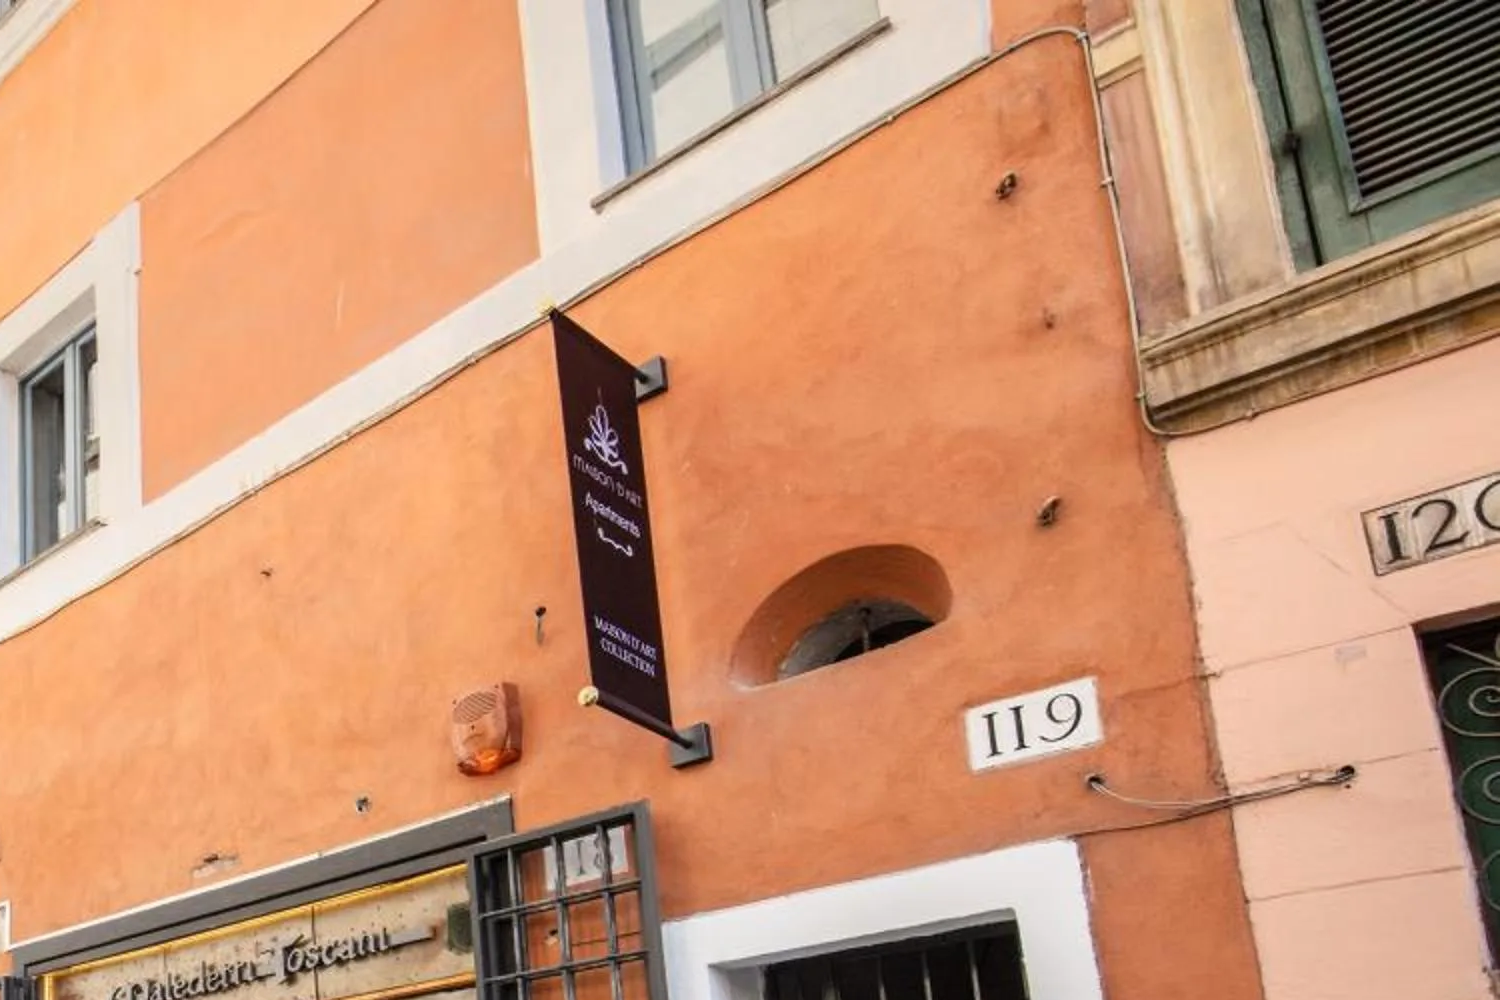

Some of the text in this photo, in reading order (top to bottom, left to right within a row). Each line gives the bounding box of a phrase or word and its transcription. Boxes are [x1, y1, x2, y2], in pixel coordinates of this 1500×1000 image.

[585, 491, 641, 538] Apartments
[600, 637, 656, 677] COLLECTION
[982, 693, 1082, 758] 119
